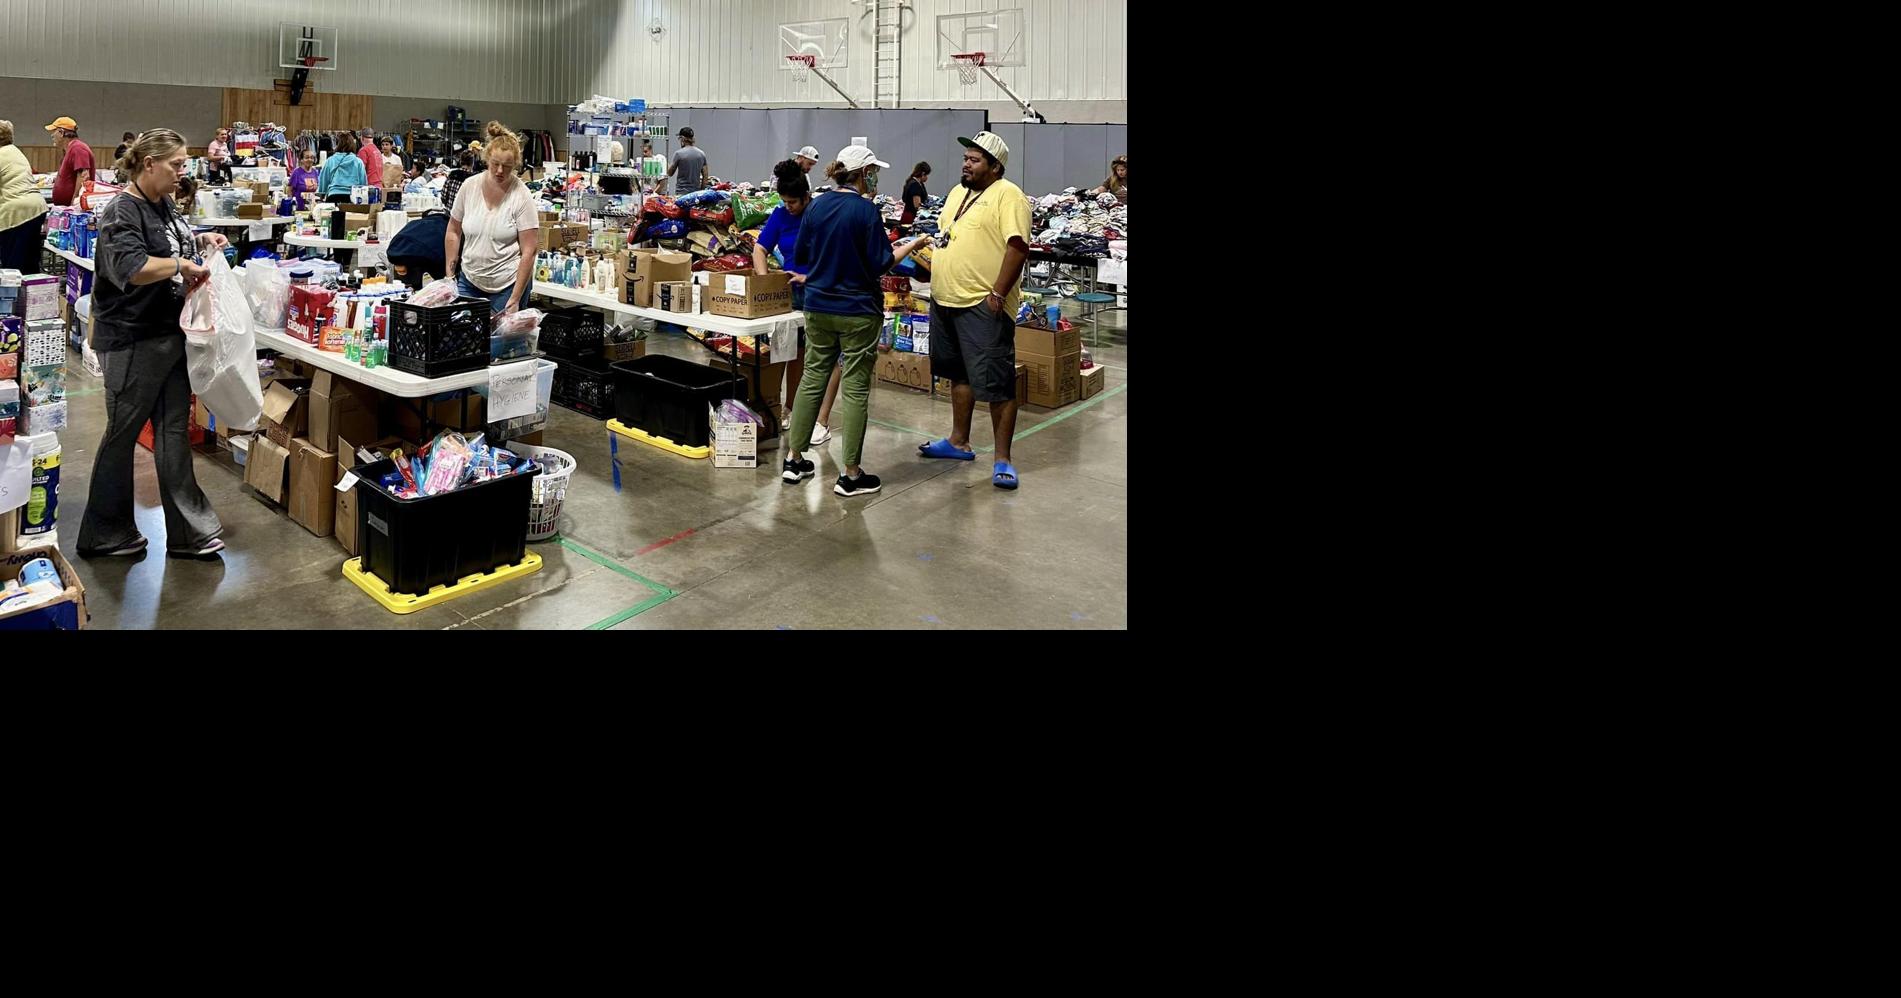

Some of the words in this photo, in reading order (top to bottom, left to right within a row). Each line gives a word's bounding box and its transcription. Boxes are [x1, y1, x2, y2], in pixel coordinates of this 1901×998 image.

[716, 296, 730, 304] COPY
[731, 297, 748, 306] PAPER
[757, 292, 772, 302] COPY
[773, 290, 789, 300] PAPER
[492, 391, 530, 410] HYGIENE
